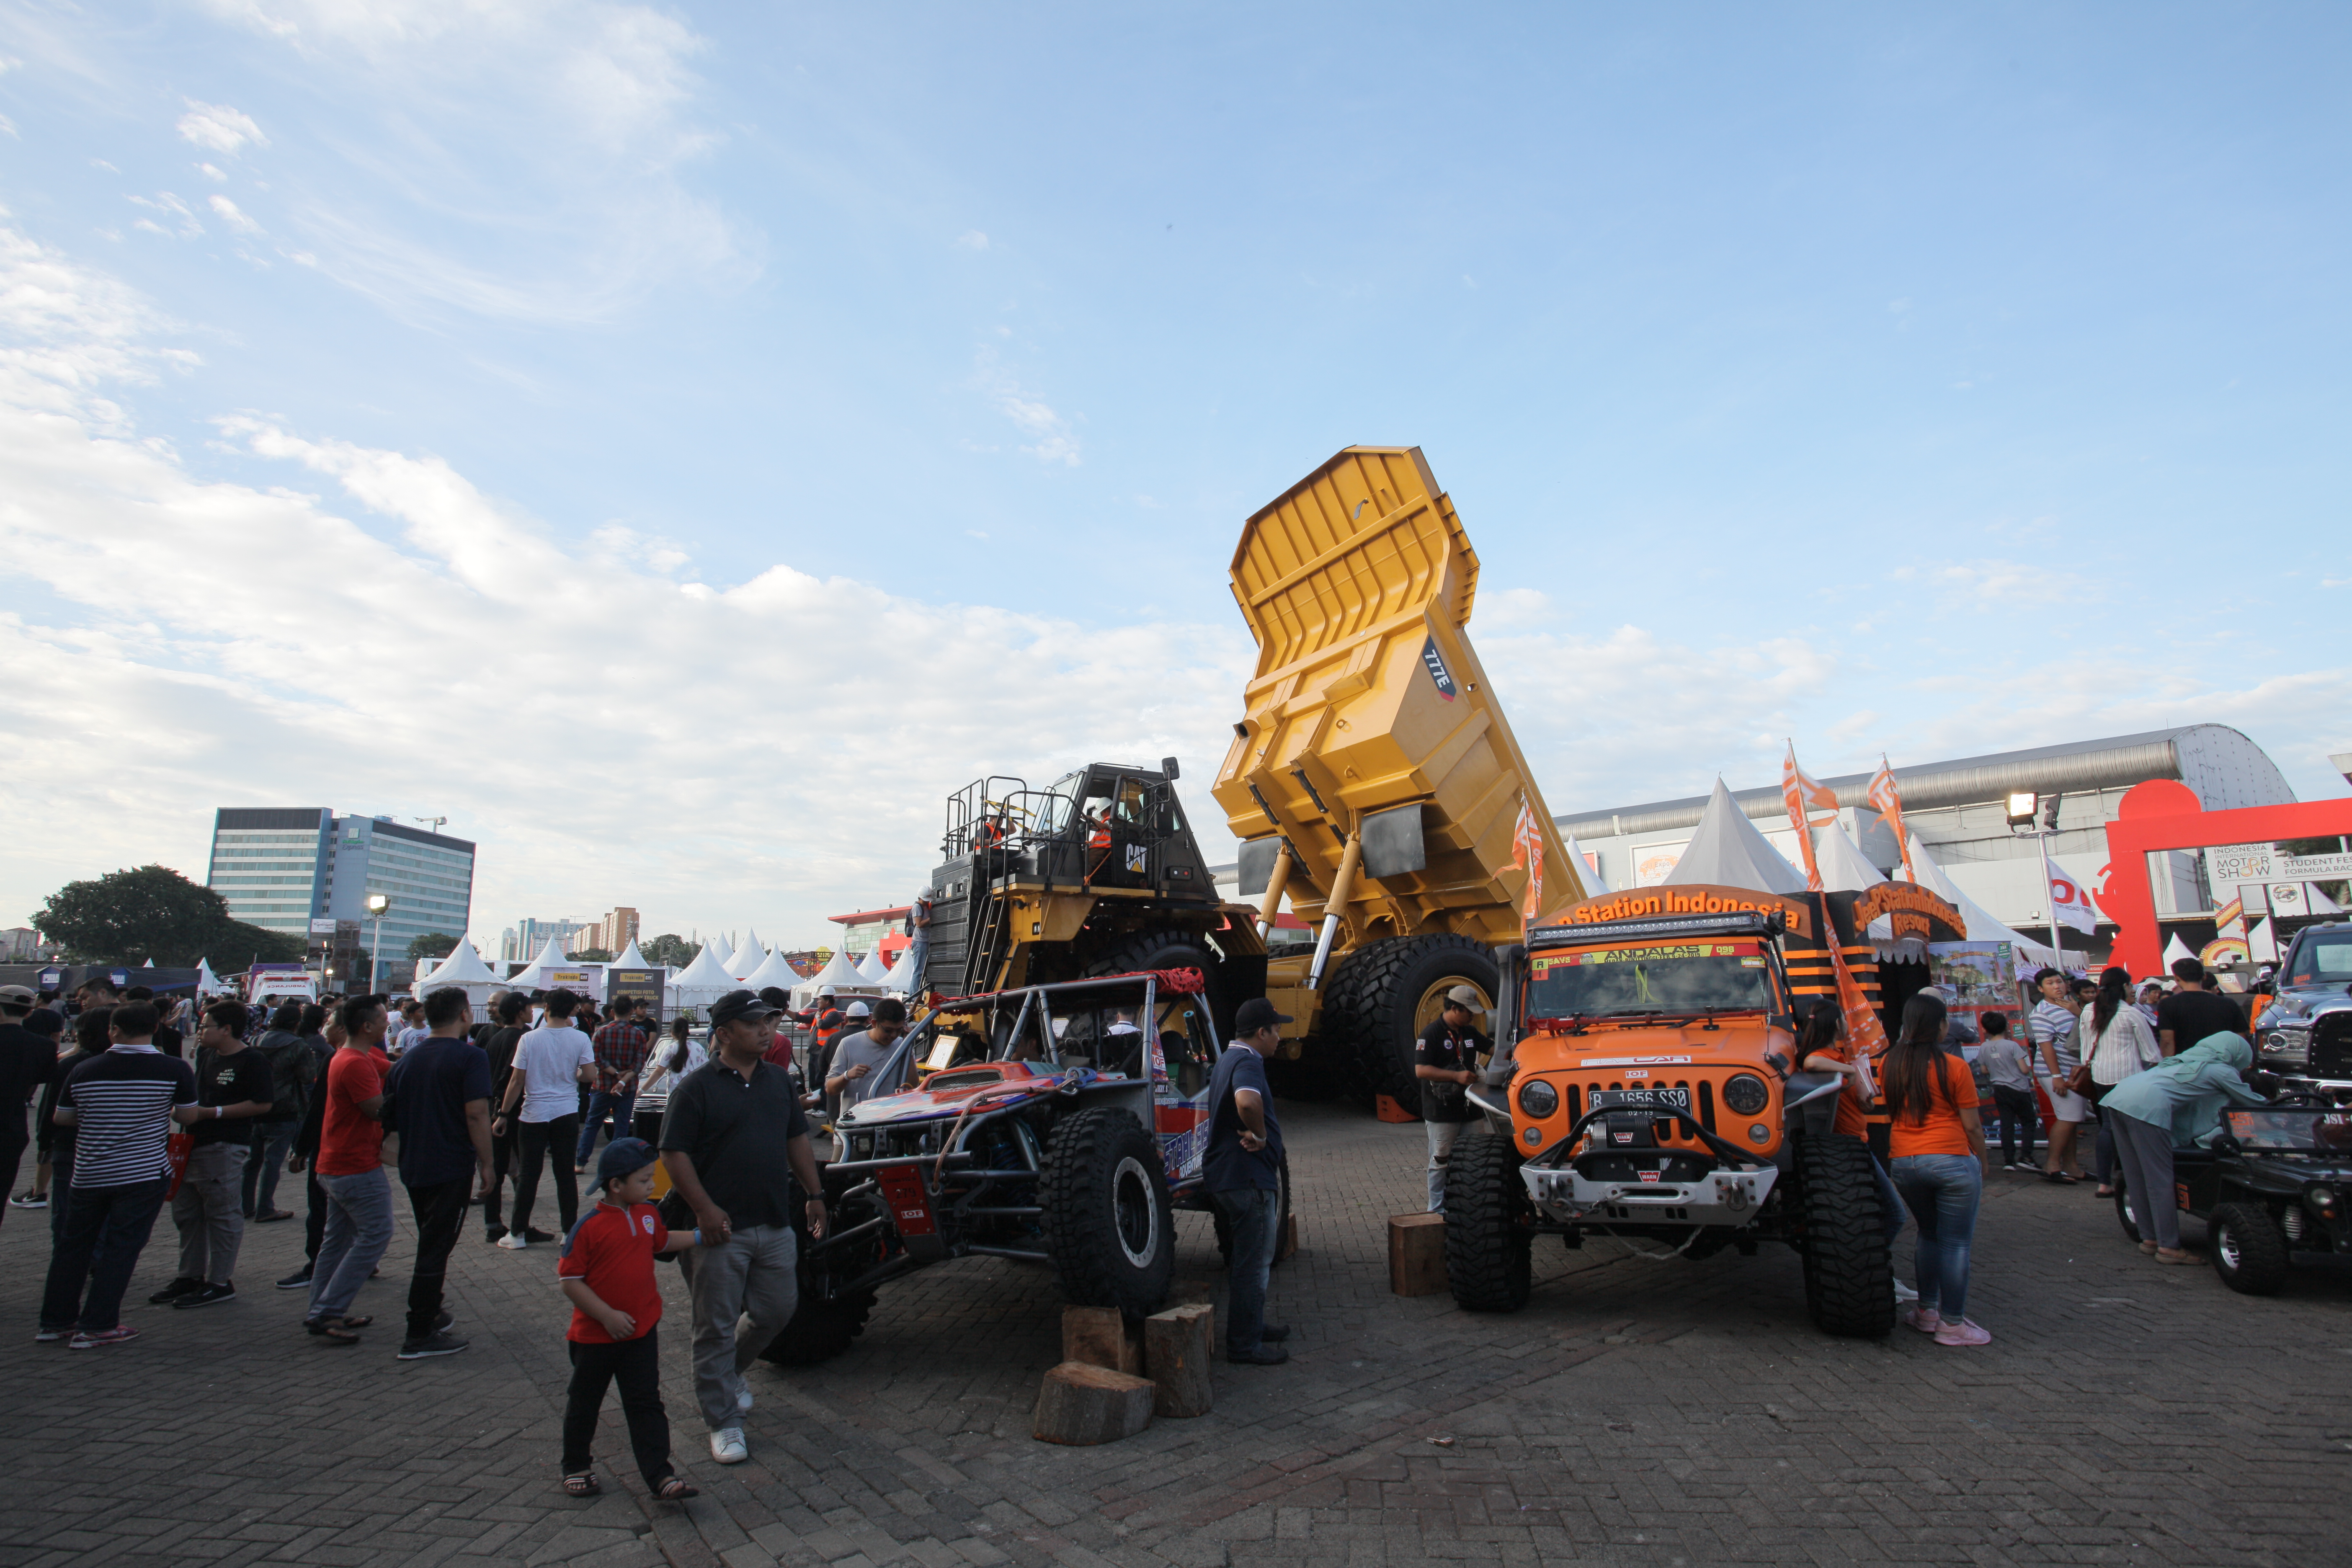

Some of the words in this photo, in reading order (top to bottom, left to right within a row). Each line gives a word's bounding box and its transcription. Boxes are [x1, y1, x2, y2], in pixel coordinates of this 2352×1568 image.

[1425, 649, 1450, 688] 777E
[2214, 845, 2267, 854] INDONESIA
[1126, 843, 1147, 873] CAT
[2217, 856, 2269, 869] MOTOR
[2283, 858, 2333, 867] STUDENT
[2218, 865, 2270, 879] SHOW
[2285, 867, 2331, 875] FORMULA
[1878, 885, 1921, 912] Station
[1575, 896, 1662, 925] Station
[1893, 913, 1930, 937] Resort
[1605, 945, 1700, 960] ANDALAS
[1549, 957, 1571, 965] SAVE
[1152, 1056, 1165, 1067] IOF
[1593, 1093, 1602, 1106] B
[2324, 1114, 2344, 1124] JSI
